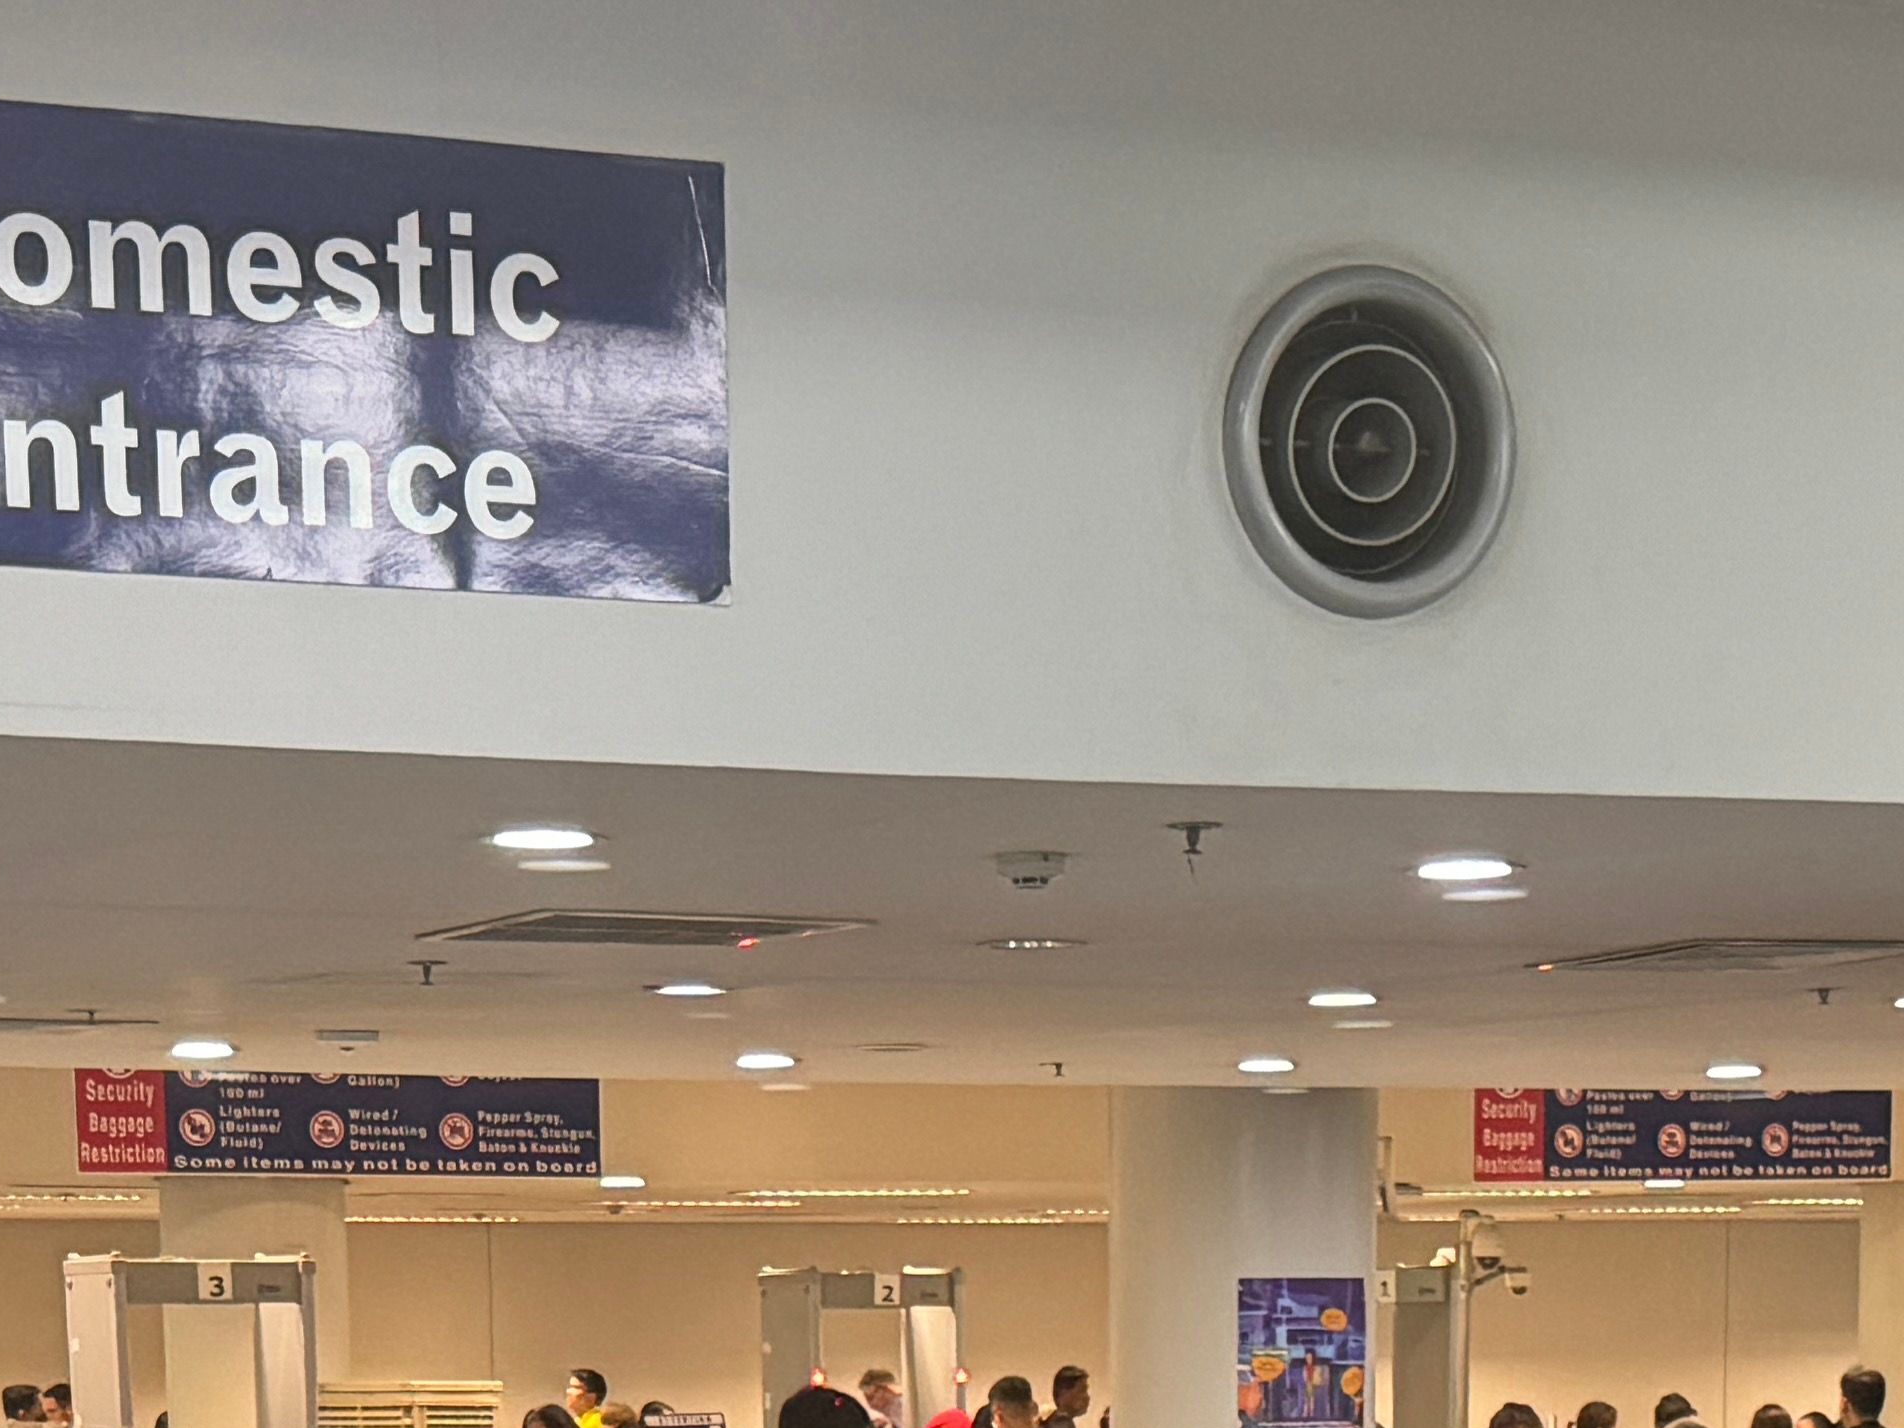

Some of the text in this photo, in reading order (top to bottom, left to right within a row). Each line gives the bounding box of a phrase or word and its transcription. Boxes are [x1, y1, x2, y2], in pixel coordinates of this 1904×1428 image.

[86, 1079, 155, 1107] Security
[219, 1106, 280, 1120] Lighters
[348, 1109, 389, 1121] Wired
[477, 1111, 521, 1124] Pepper
[1482, 1098, 1537, 1124] Security
[88, 1112, 154, 1138] Baggage
[349, 1124, 428, 1139] Detonating
[80, 1142, 166, 1164] Restriction
[350, 1140, 406, 1152] Devices
[174, 1156, 597, 1174] Some items may not be taken on board
[1475, 1155, 1543, 1174] Restriction
[1549, 1165, 1599, 1177] Some
[1699, 1164, 1728, 1176] not
[1758, 1164, 1807, 1176] taken
[1838, 1164, 1888, 1176] board
[208, 1276, 225, 1297] 3
[881, 1285, 895, 1303] 2
[1380, 1280, 1392, 1297] 1
